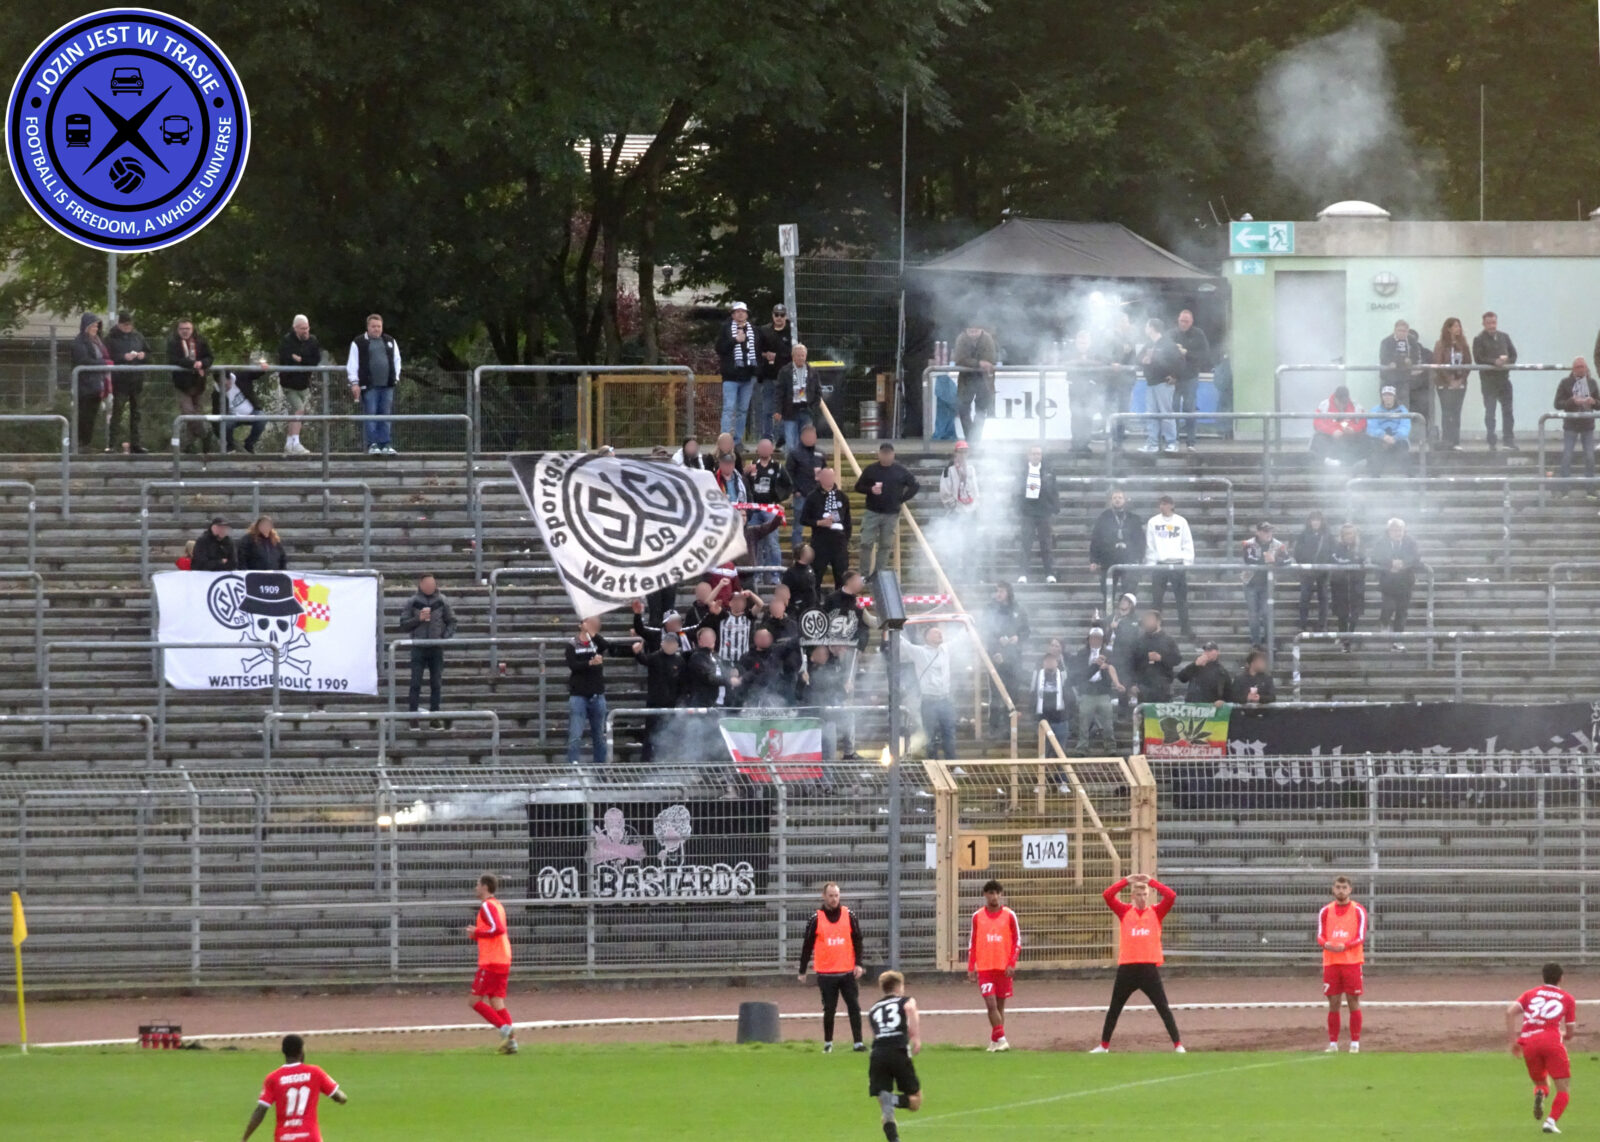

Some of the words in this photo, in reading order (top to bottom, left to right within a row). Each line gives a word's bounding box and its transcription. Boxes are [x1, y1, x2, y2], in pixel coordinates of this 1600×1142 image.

[644, 526, 677, 552] 09
[582, 513, 729, 593] Wattenscheid
[259, 585, 280, 594] 1909
[317, 677, 349, 691] 1909
[967, 840, 976, 866] 1
[1026, 840, 1066, 861] A1/A2
[594, 861, 756, 899] BASTARDS
[981, 982, 993, 995] 27
[873, 1003, 901, 1028] 13
[1524, 996, 1564, 1019] 30
[286, 1086, 310, 1116] 11
